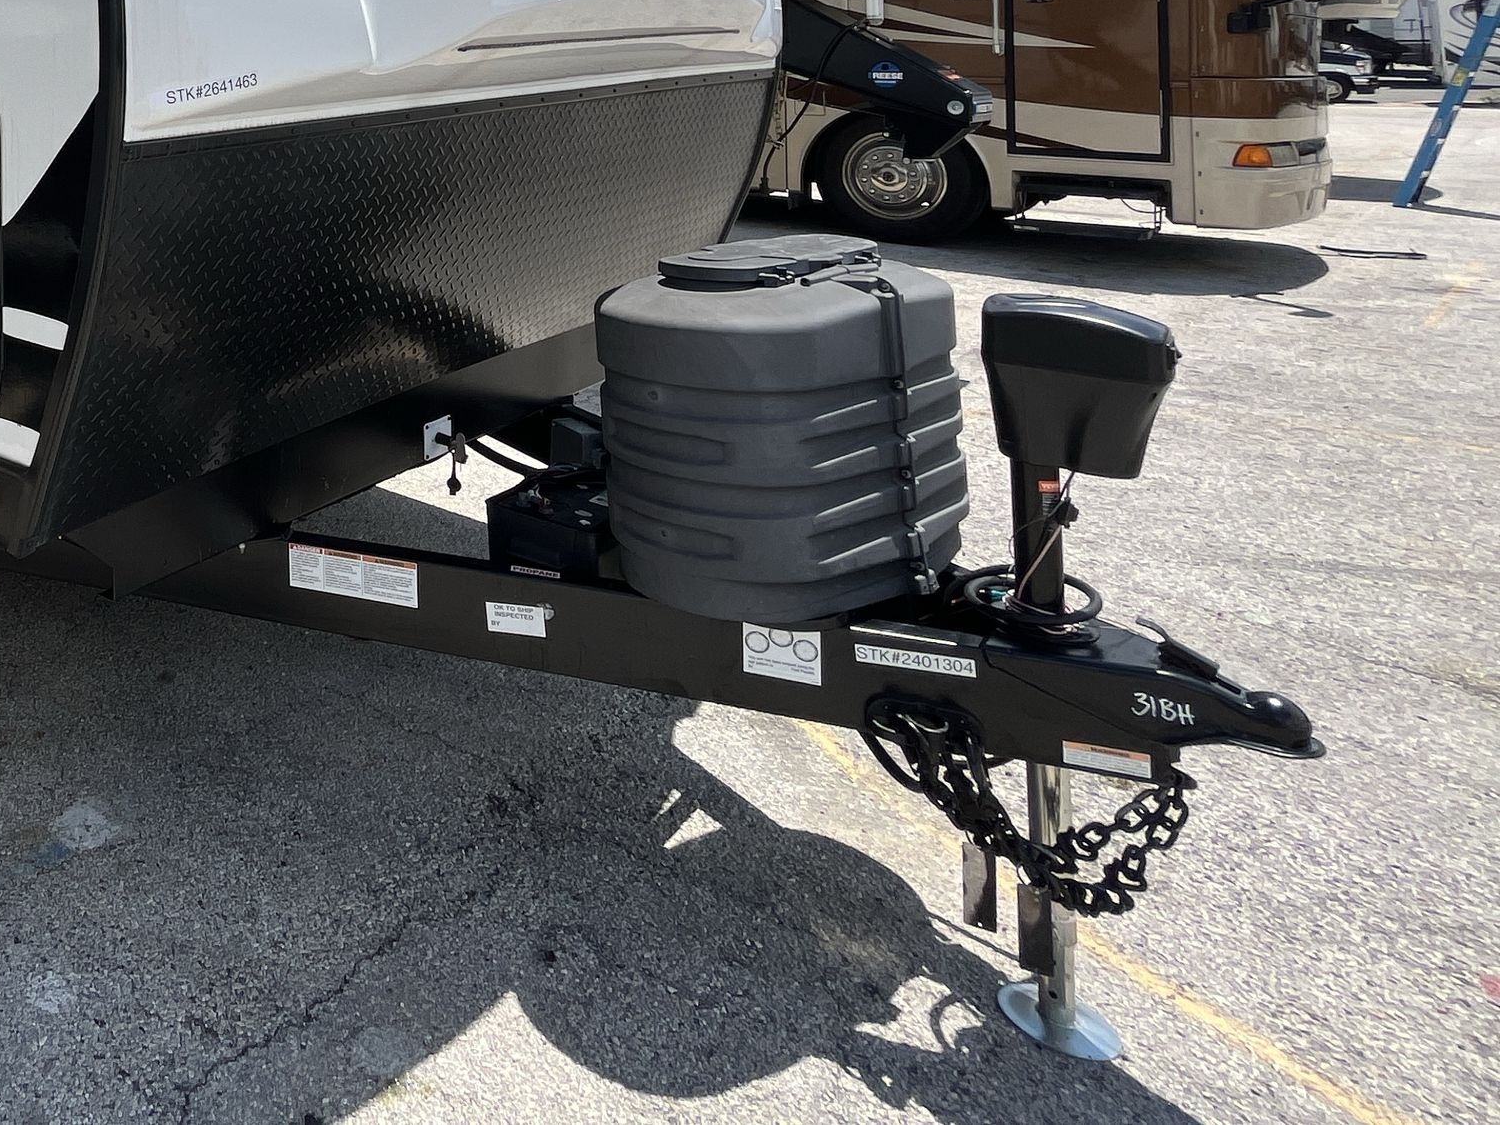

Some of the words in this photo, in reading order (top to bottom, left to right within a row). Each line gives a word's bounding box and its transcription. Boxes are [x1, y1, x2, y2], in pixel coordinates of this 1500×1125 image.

[166, 73, 258, 104] STK#2641463
[512, 565, 559, 577] PROPANE
[494, 611, 534, 621] INSPECTED
[856, 646, 974, 674] STK#2401304
[1130, 692, 1196, 726] 31BH
